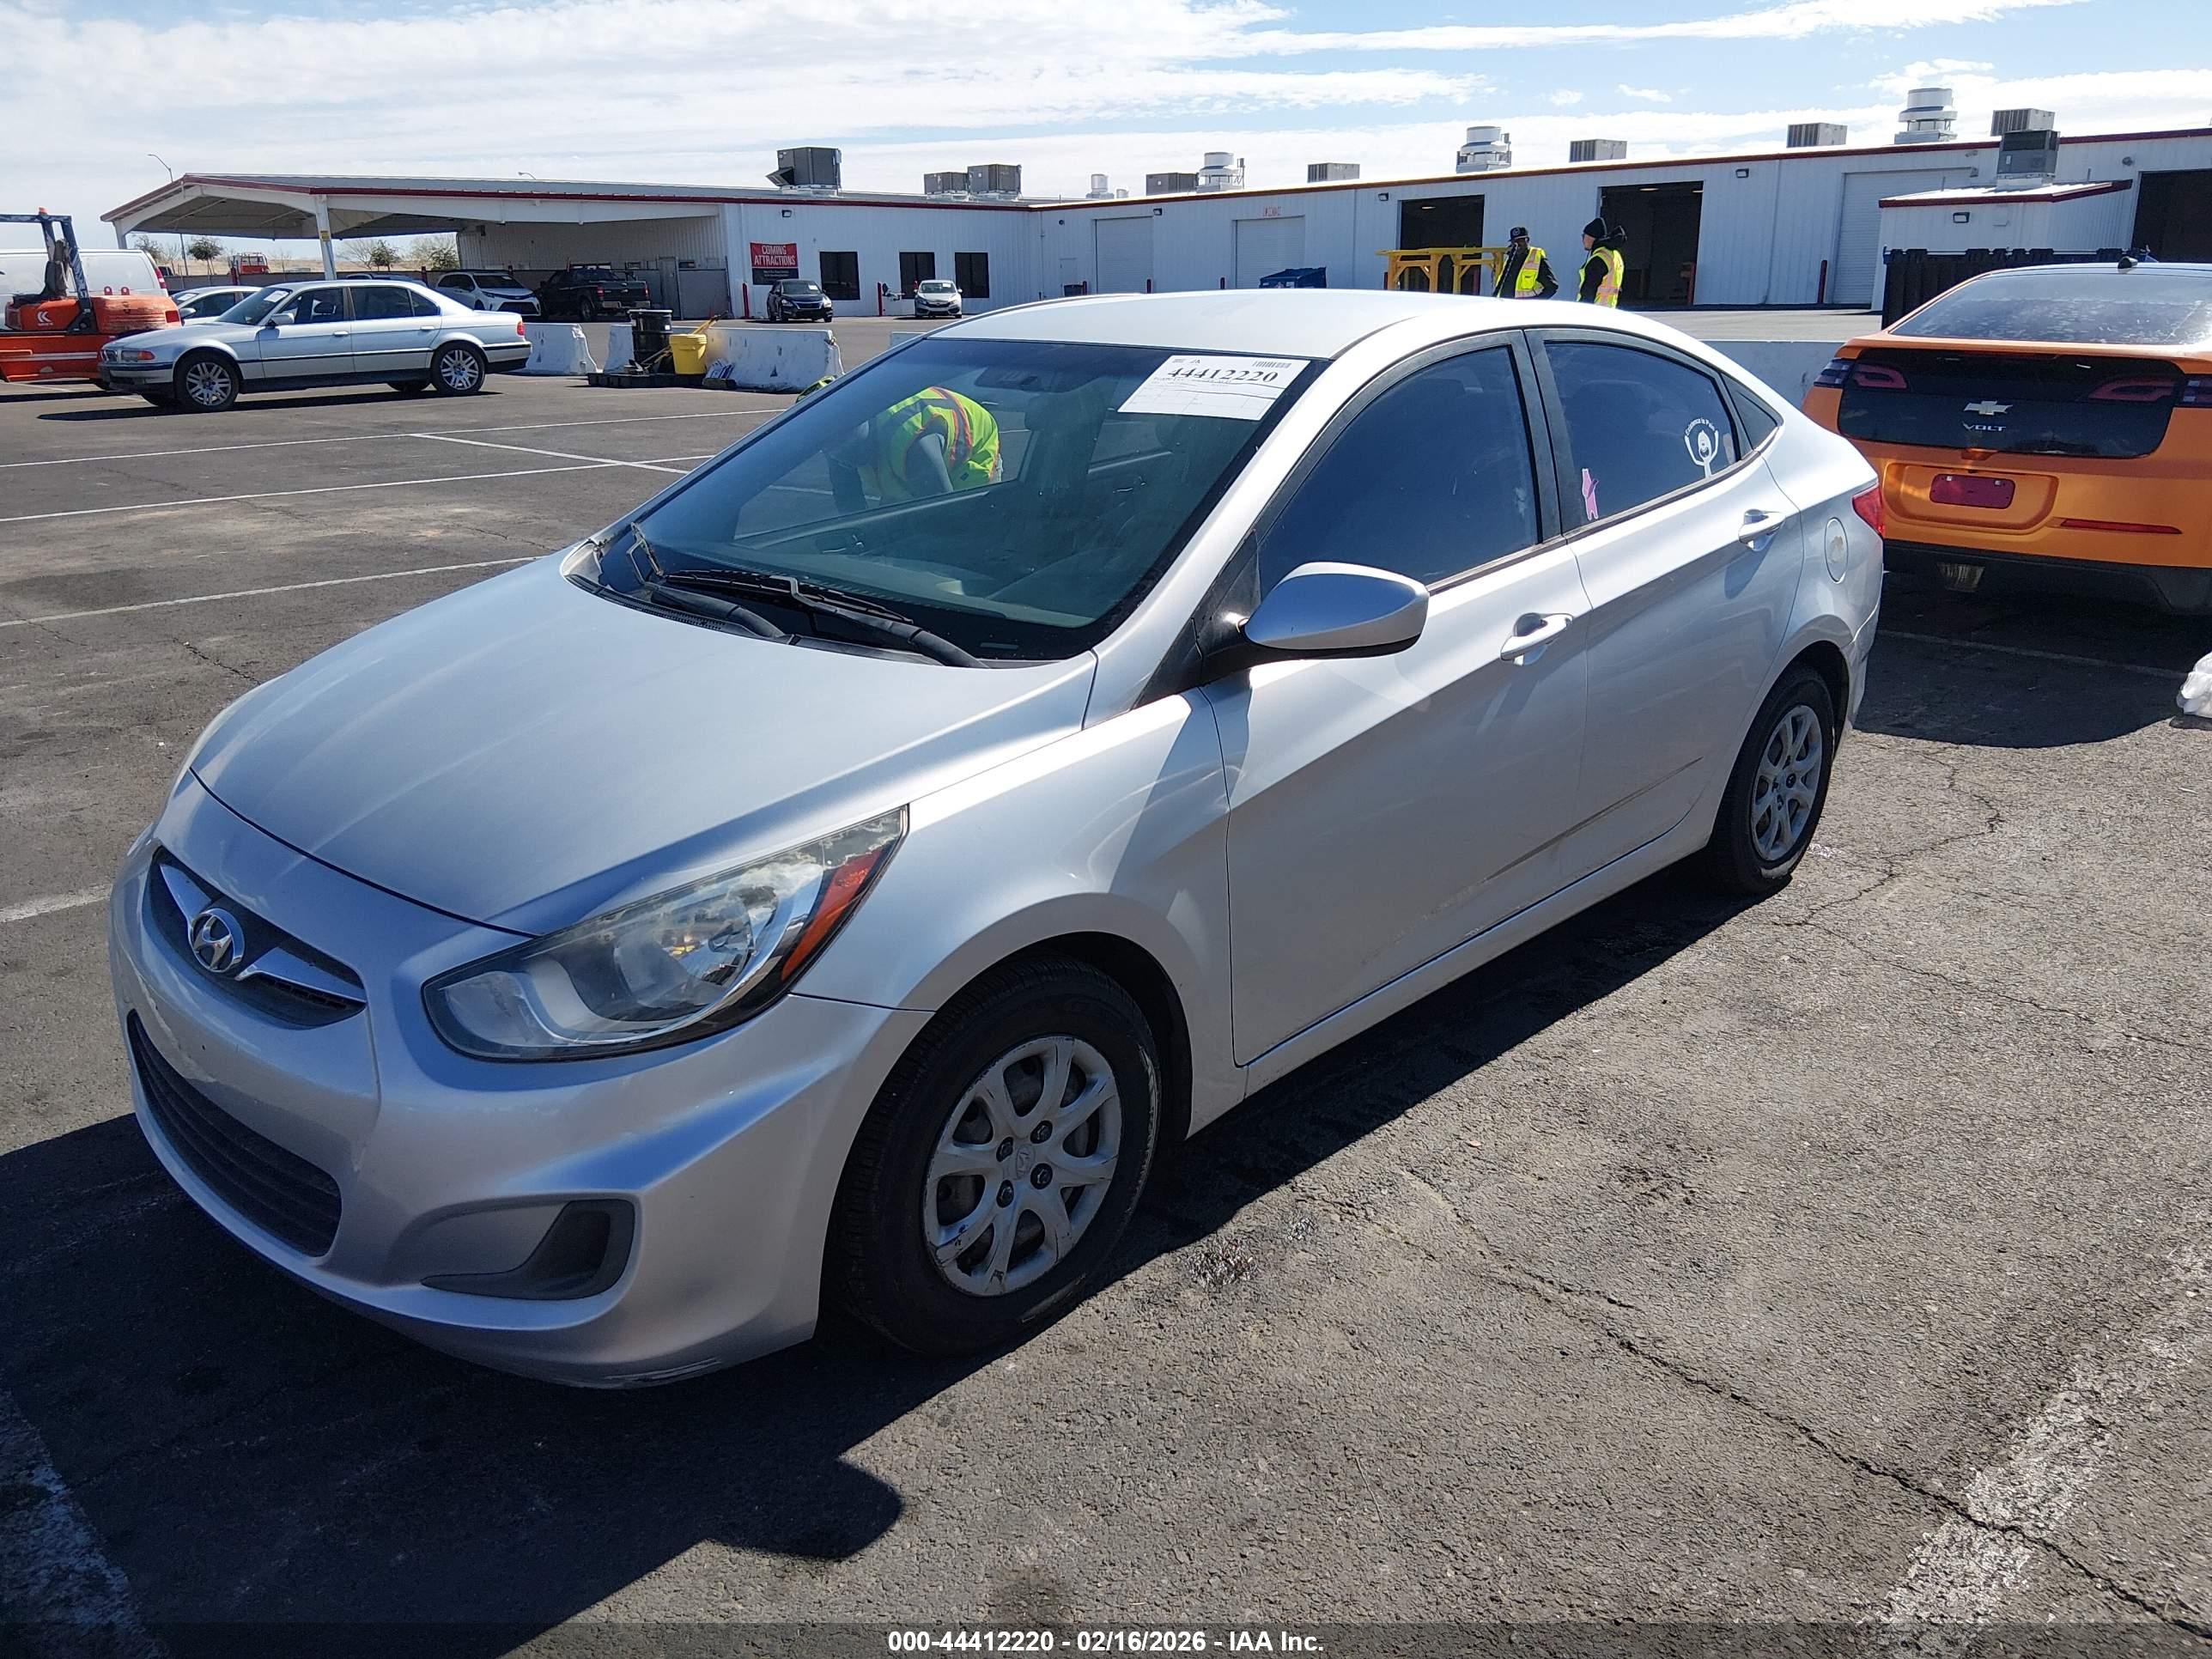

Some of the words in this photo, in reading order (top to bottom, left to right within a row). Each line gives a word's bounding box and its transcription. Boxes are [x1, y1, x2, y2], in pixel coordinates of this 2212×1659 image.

[762, 246, 787, 255] COMING
[754, 255, 796, 265] ATTRACTIONS
[1168, 368, 1279, 383] 44412220
[1962, 421, 2007, 432] VOLT
